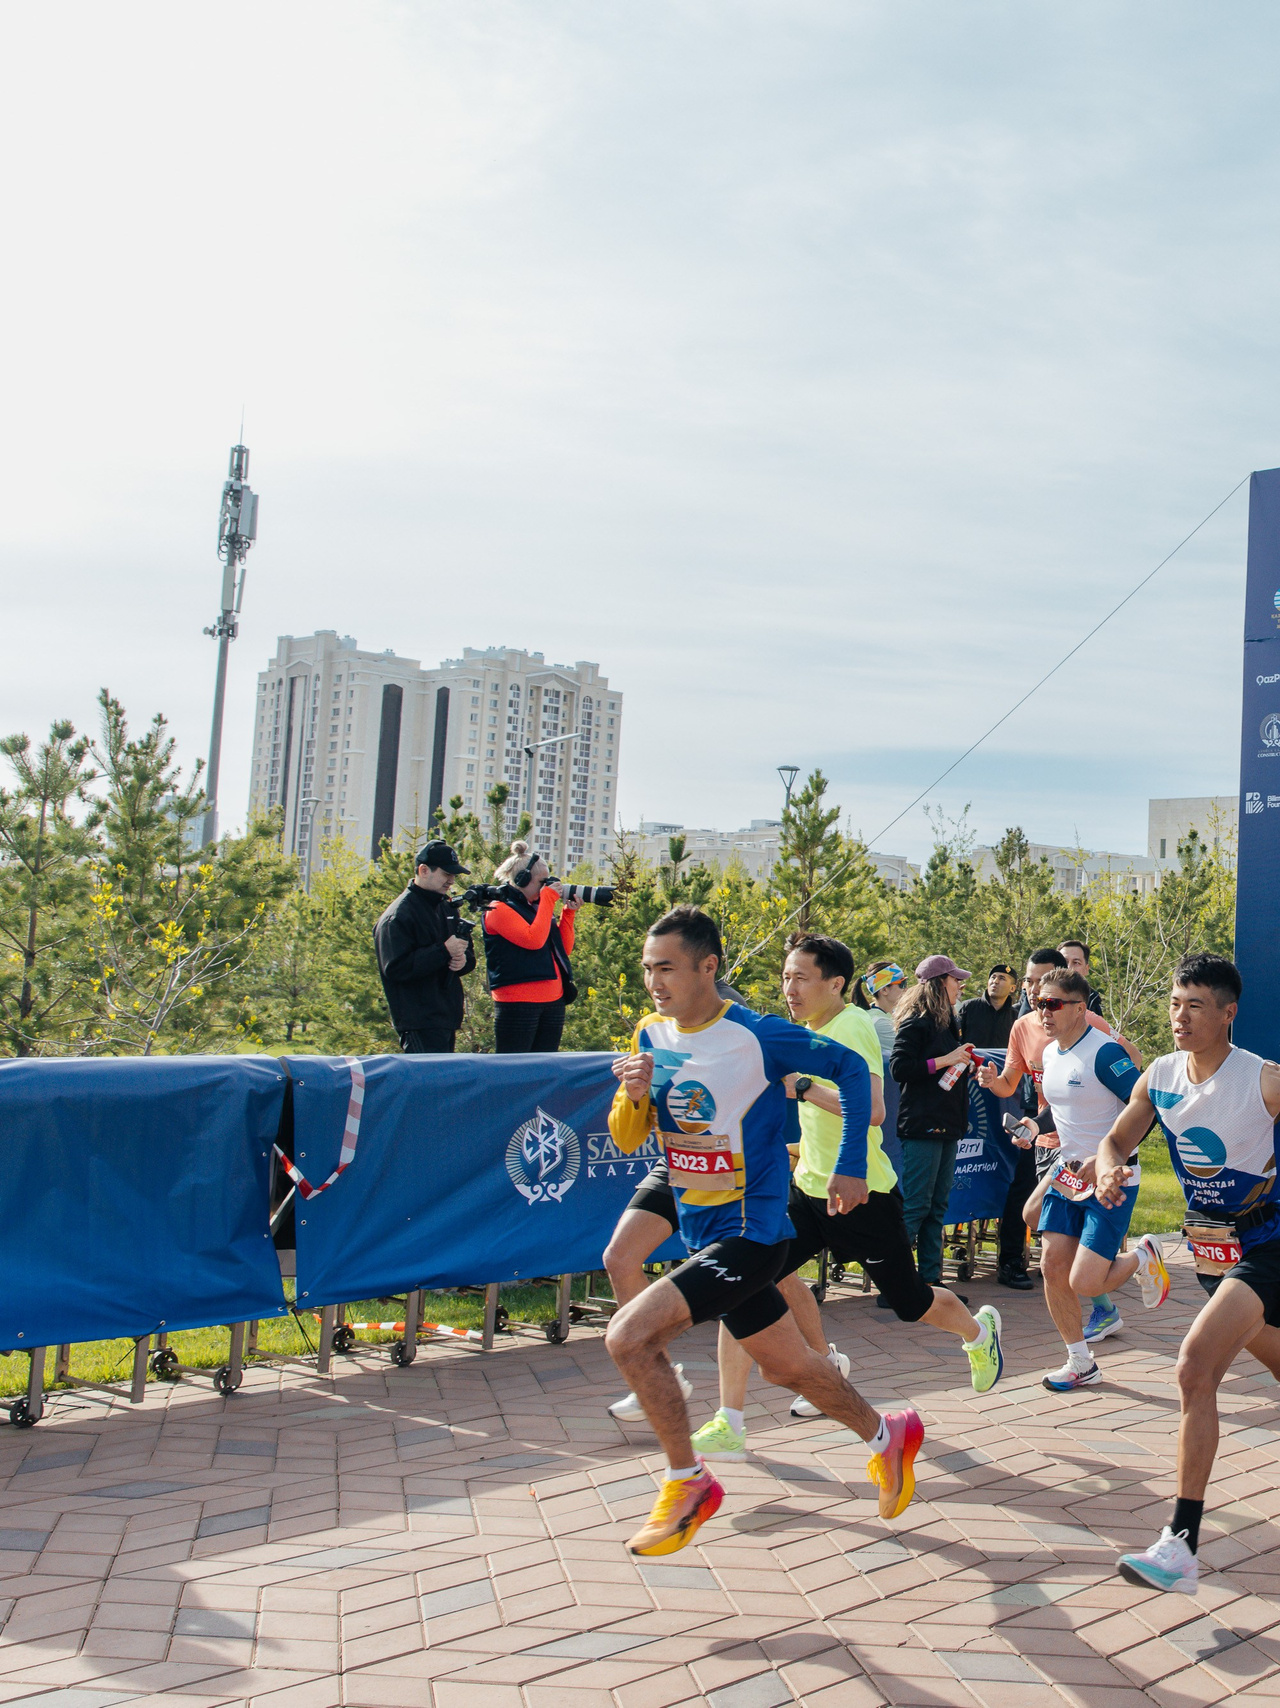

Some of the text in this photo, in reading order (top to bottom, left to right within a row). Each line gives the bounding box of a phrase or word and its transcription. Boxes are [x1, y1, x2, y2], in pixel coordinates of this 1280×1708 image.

[959, 1143, 980, 1153] RITY
[587, 1161, 653, 1178] KAZY
[671, 1152, 730, 1172] 5023 A
[954, 1162, 998, 1174] MARATHON
[1193, 1242, 1241, 1262] 5076 A
